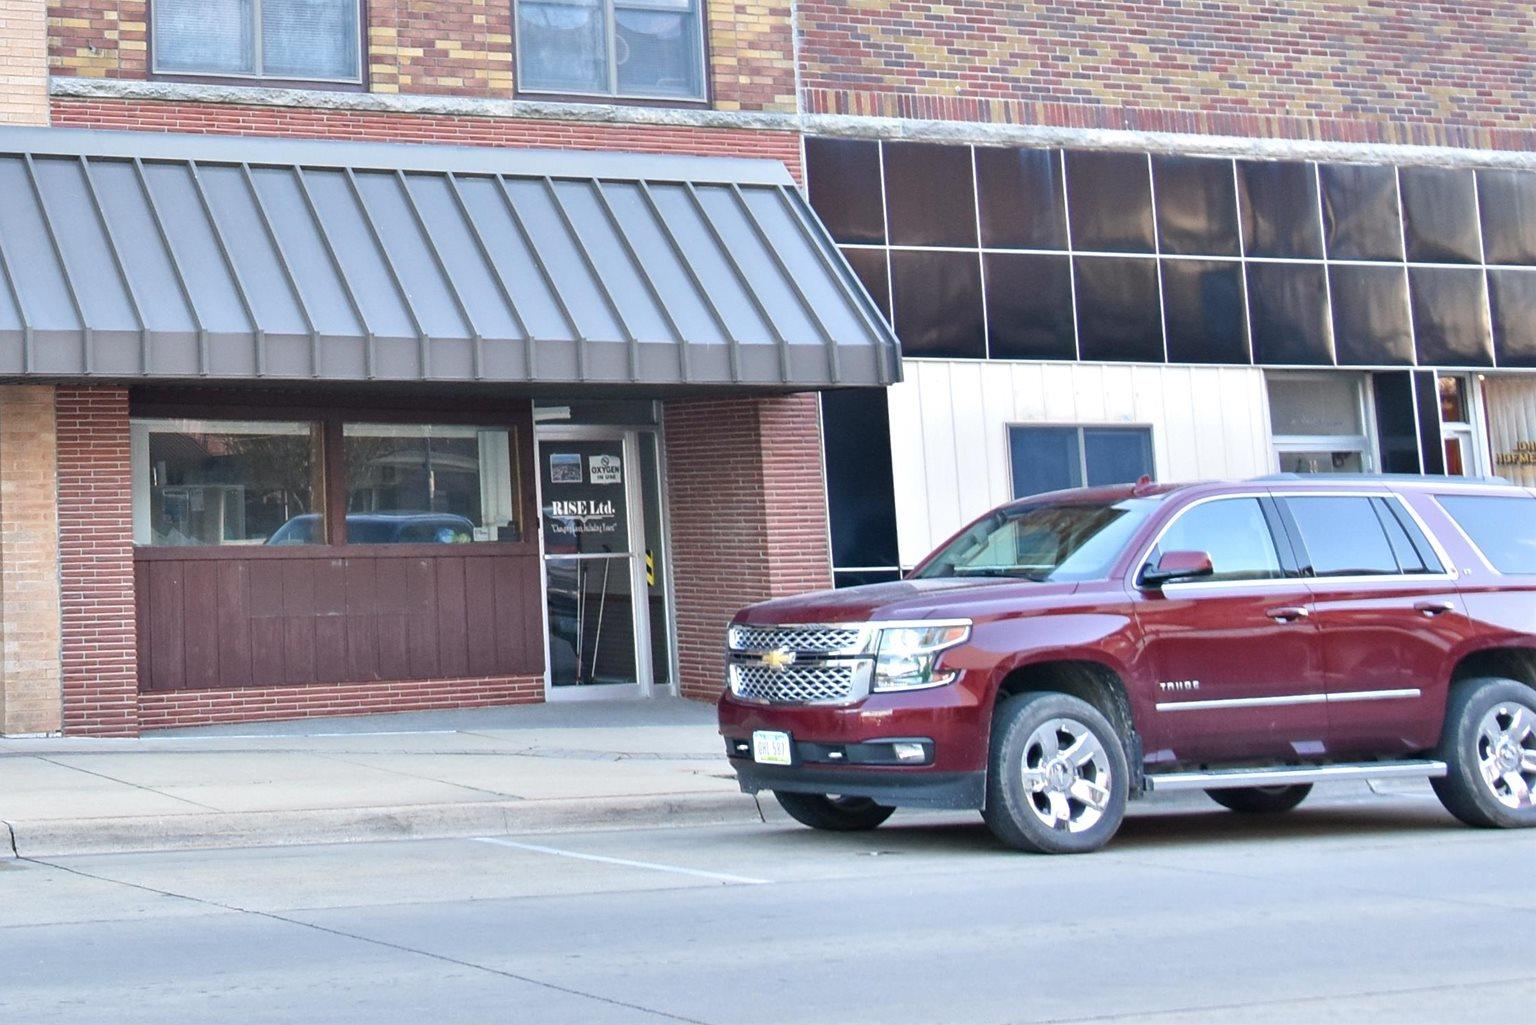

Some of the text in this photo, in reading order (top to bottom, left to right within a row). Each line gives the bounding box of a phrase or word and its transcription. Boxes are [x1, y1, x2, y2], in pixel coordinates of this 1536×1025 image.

[591, 466, 620, 474] OXYGEN
[552, 499, 616, 515] RISE Ltd.
